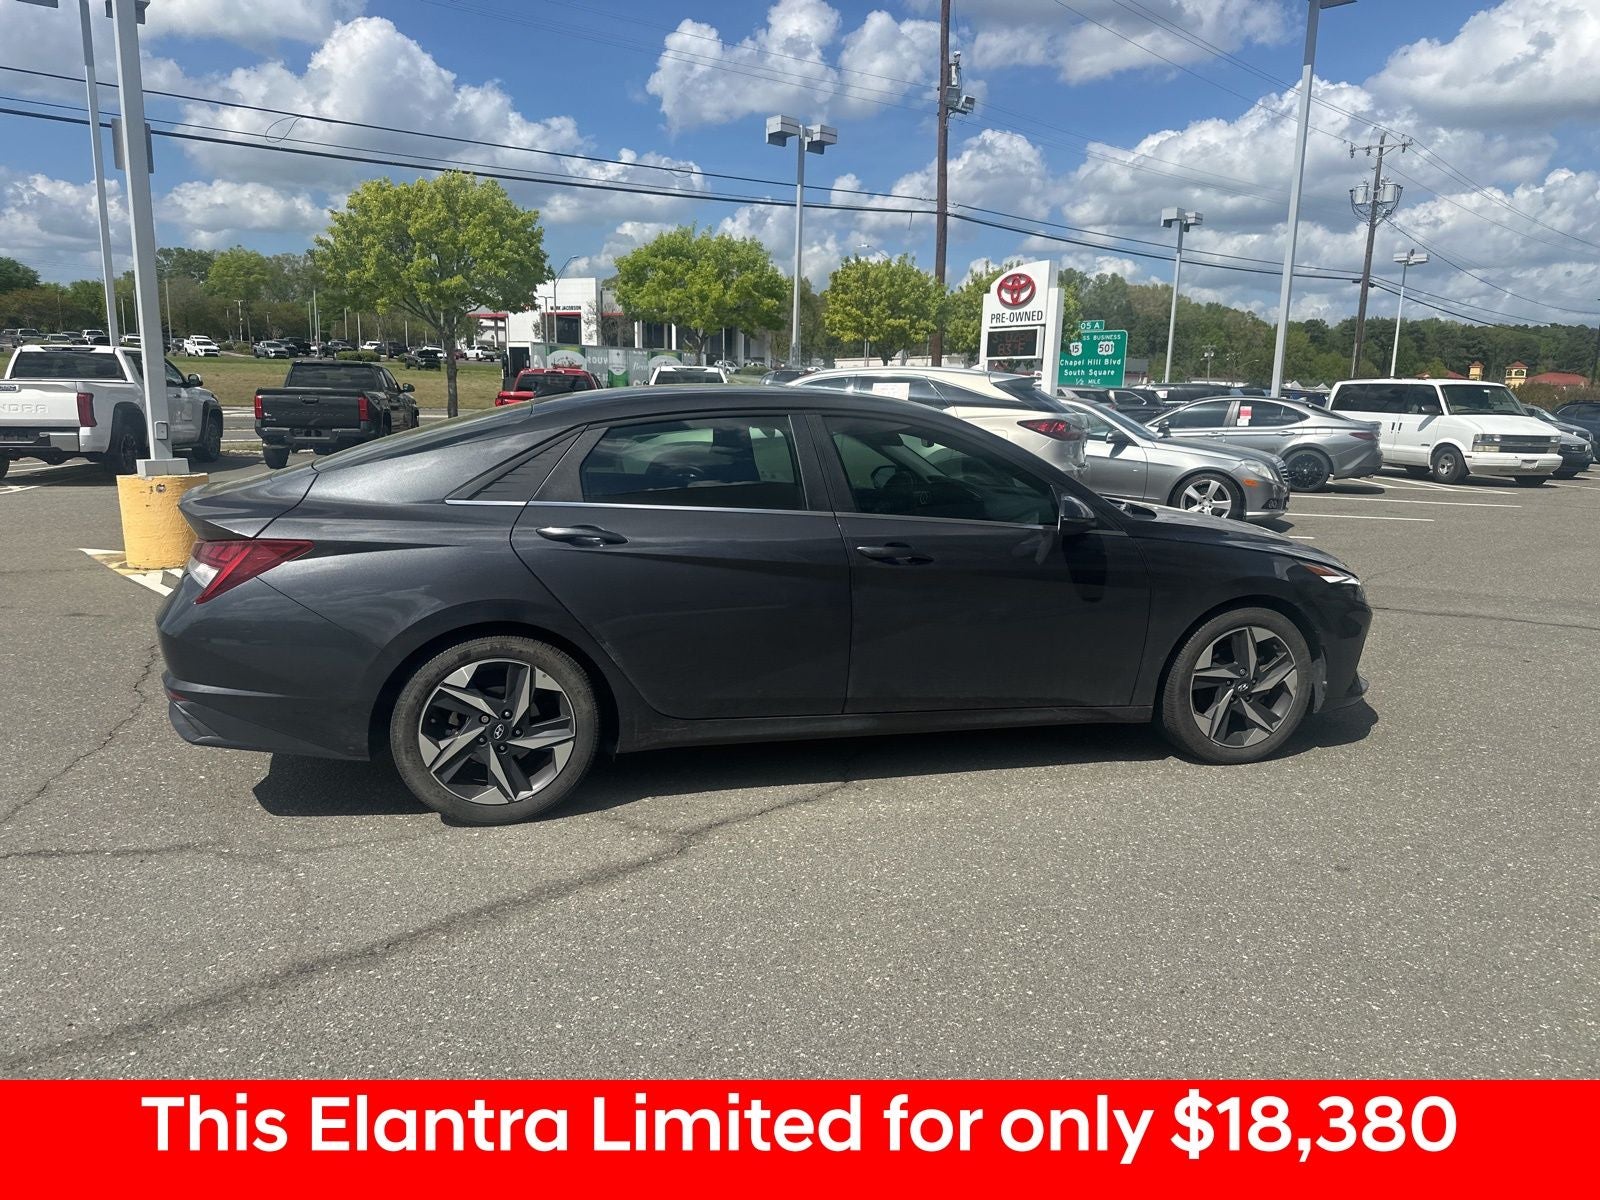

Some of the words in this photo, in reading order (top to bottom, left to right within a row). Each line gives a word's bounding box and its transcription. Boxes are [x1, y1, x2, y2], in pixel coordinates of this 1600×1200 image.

[990, 310, 1043, 324] PRE-OWNED
[1094, 322, 1100, 330] A
[1072, 344, 1080, 353] 15
[1099, 344, 1114, 353] 501
[1060, 359, 1085, 367] Chapel
[1104, 358, 1122, 366] Blvd
[1089, 369, 1115, 377] Square
